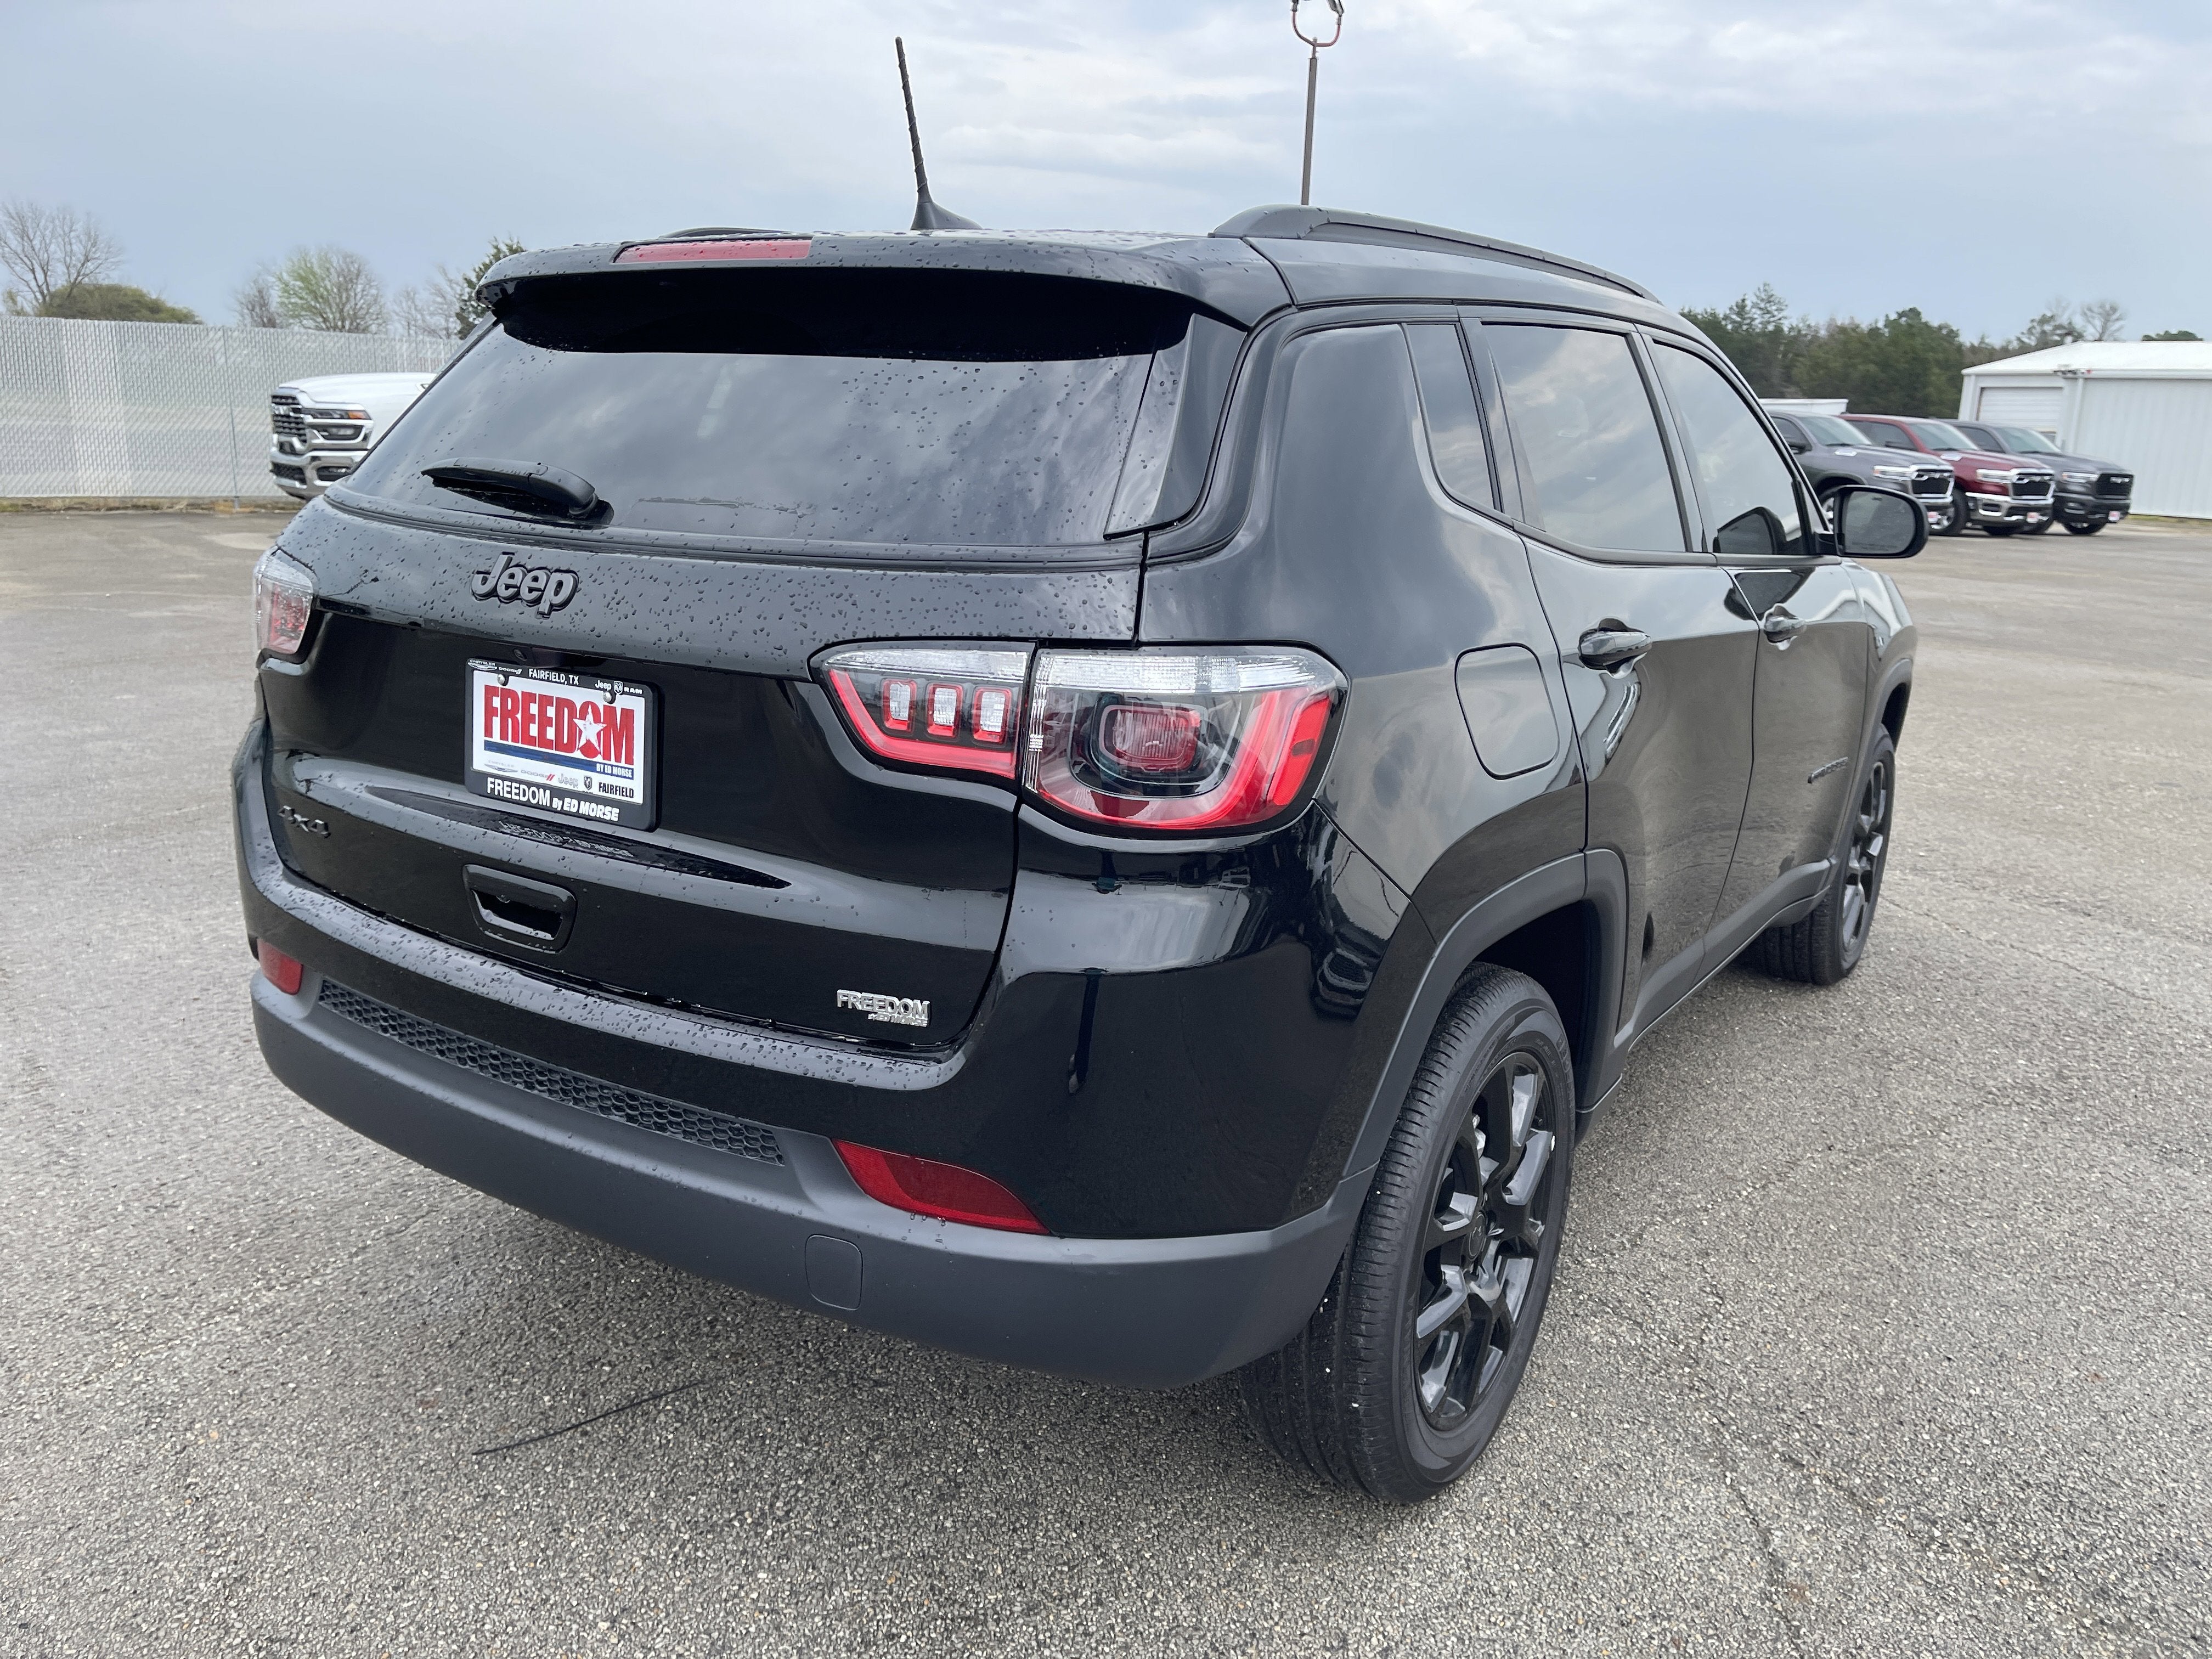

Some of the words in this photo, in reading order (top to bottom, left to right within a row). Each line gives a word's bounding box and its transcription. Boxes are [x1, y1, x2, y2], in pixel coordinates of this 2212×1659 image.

[471, 552, 578, 618] Jeep
[529, 668, 567, 685] FAIRFIELD,
[568, 674, 579, 685] TX
[595, 680, 612, 691] Jeep
[624, 686, 642, 695] RAM
[484, 684, 635, 766] FREEDOM
[596, 763, 604, 772] BY
[605, 764, 612, 774] ED
[612, 766, 633, 778] MORSE
[557, 773, 579, 788] Jeep
[599, 781, 634, 799] FAIRFIELD
[487, 777, 550, 807] FREEDOM
[563, 797, 578, 813] ED
[579, 800, 620, 822] MORSE
[837, 989, 930, 1020] FREEDOM
